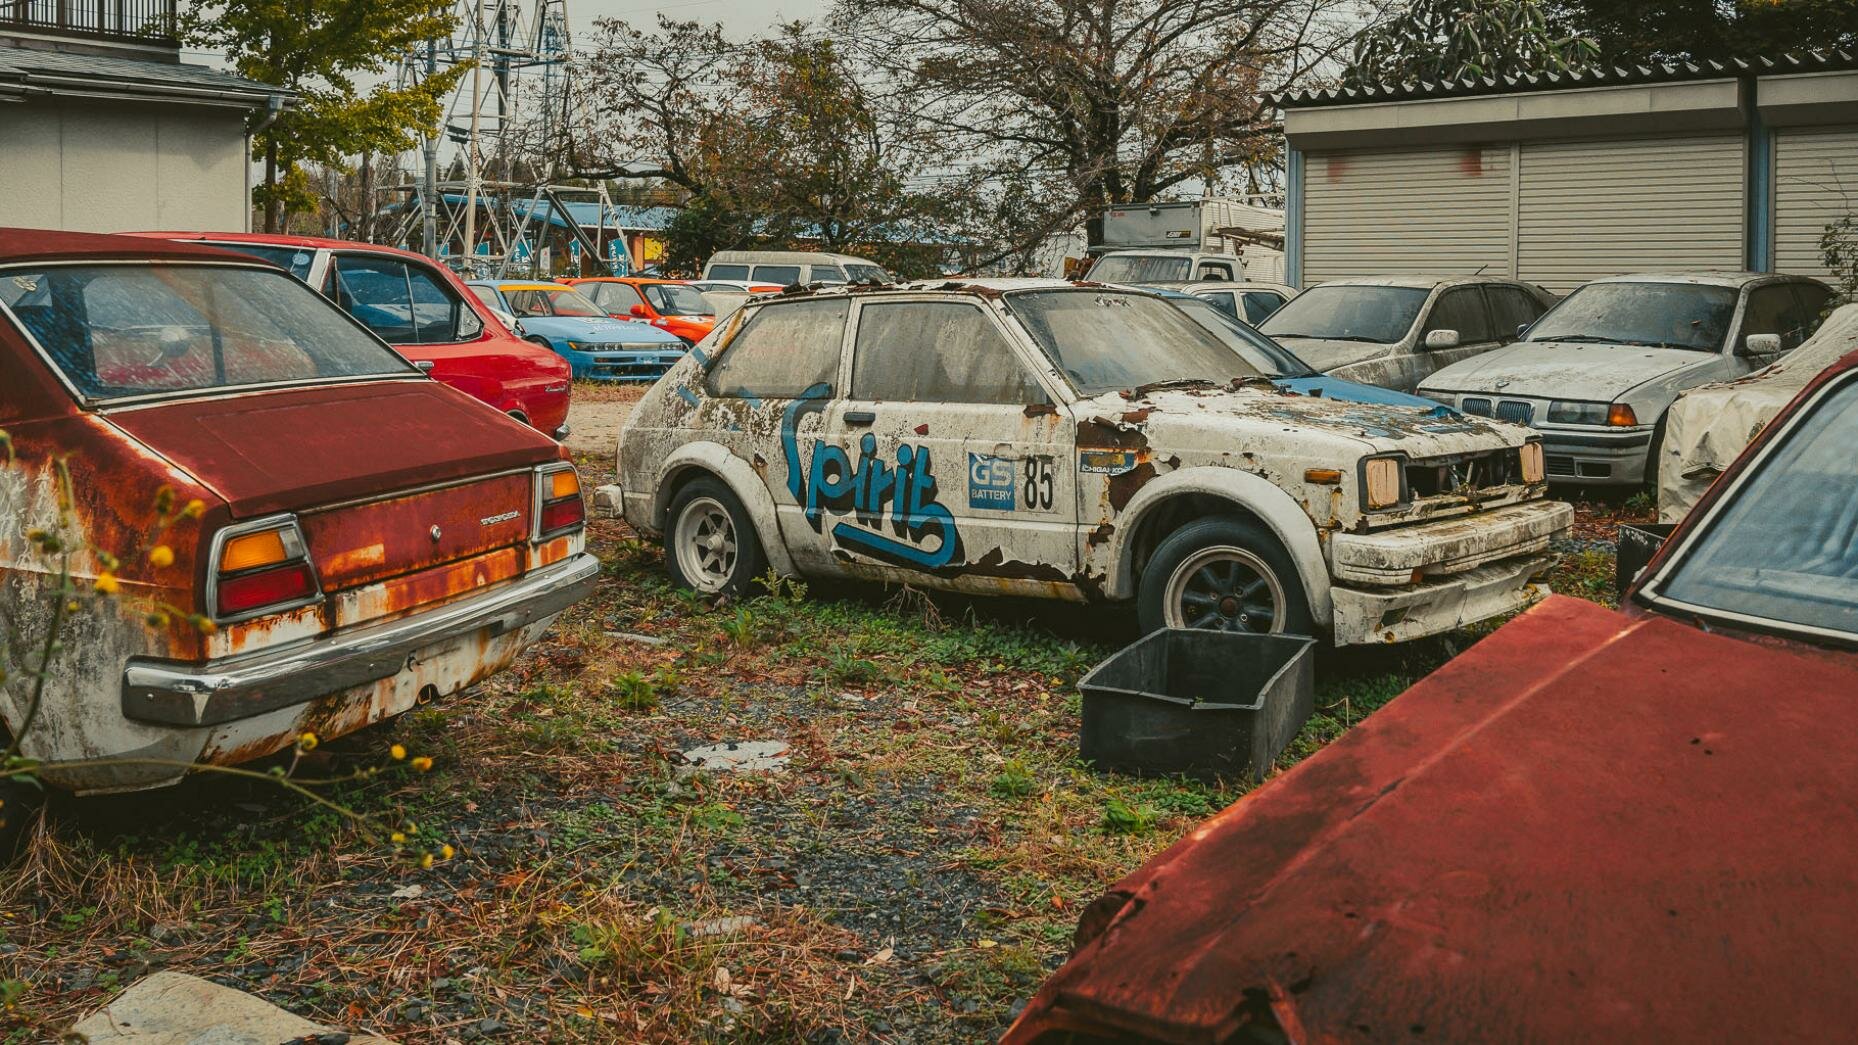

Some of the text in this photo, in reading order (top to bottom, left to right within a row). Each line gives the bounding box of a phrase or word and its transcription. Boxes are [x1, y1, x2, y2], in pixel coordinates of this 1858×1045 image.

[781, 382, 966, 571] Spirit
[971, 459, 1012, 486] GS
[1024, 454, 1053, 510] 85
[972, 488, 1012, 501] BATTERY
